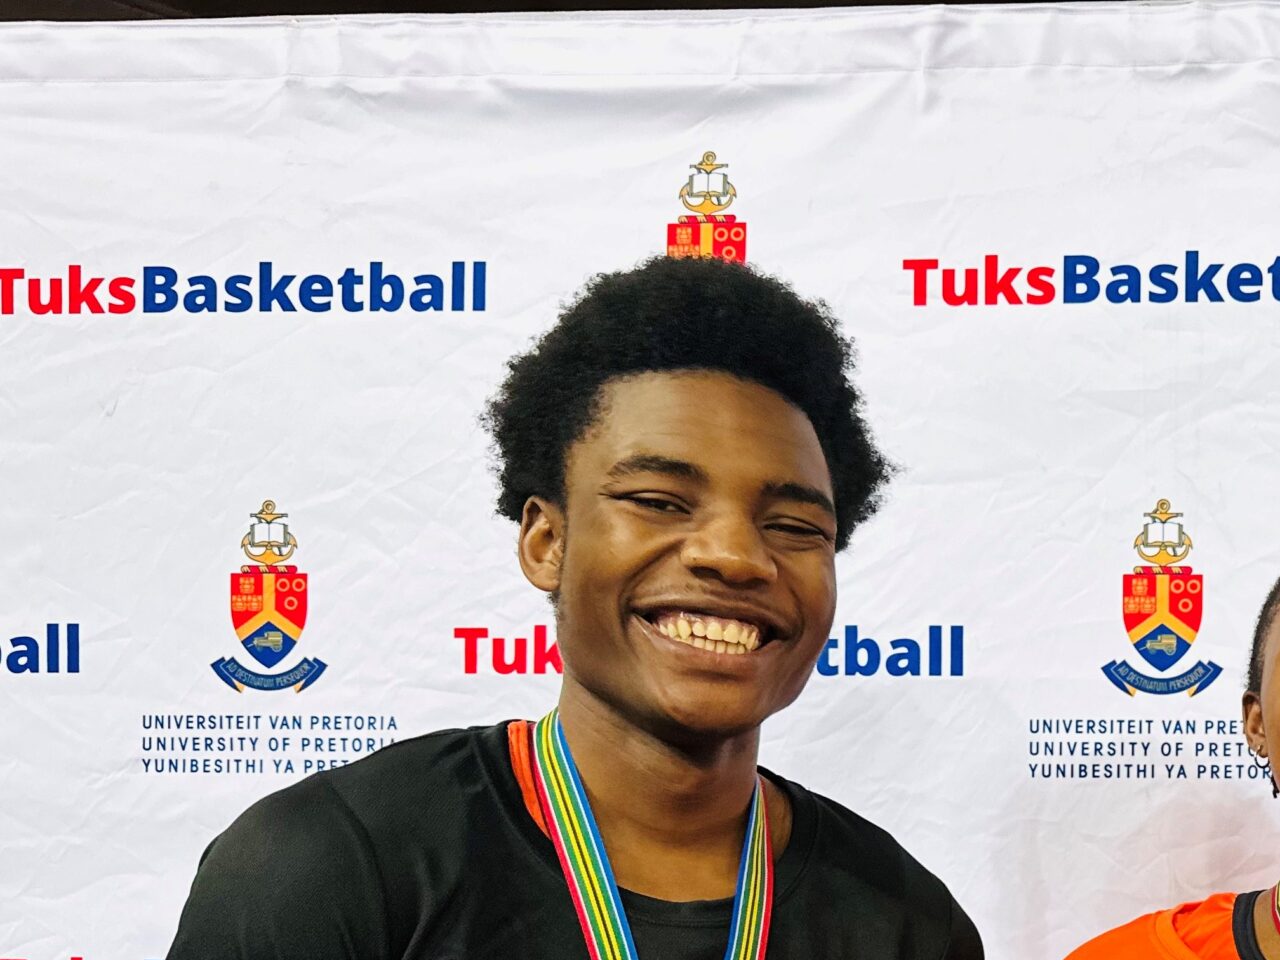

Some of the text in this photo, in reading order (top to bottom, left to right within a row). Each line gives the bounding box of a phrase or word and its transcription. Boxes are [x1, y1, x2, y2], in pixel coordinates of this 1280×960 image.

[0, 261, 486, 315] TuksBasketball
[0, 623, 80, 674] all
[142, 715, 398, 730] UNIVERSITEIT VAN PRETORIA
[1029, 719, 1153, 734] UNIVERSITEIT
[1163, 720, 1196, 734] VAN
[142, 737, 395, 752] UNIVERSITY OF PRETORI
[1029, 742, 1151, 757] UNIVERSITY
[1161, 743, 1183, 757] OF
[142, 759, 264, 774] YUNIBESITHI
[273, 760, 294, 774] YA
[1029, 764, 1155, 779] YUNIBESITHI
[1165, 765, 1187, 779] YA
